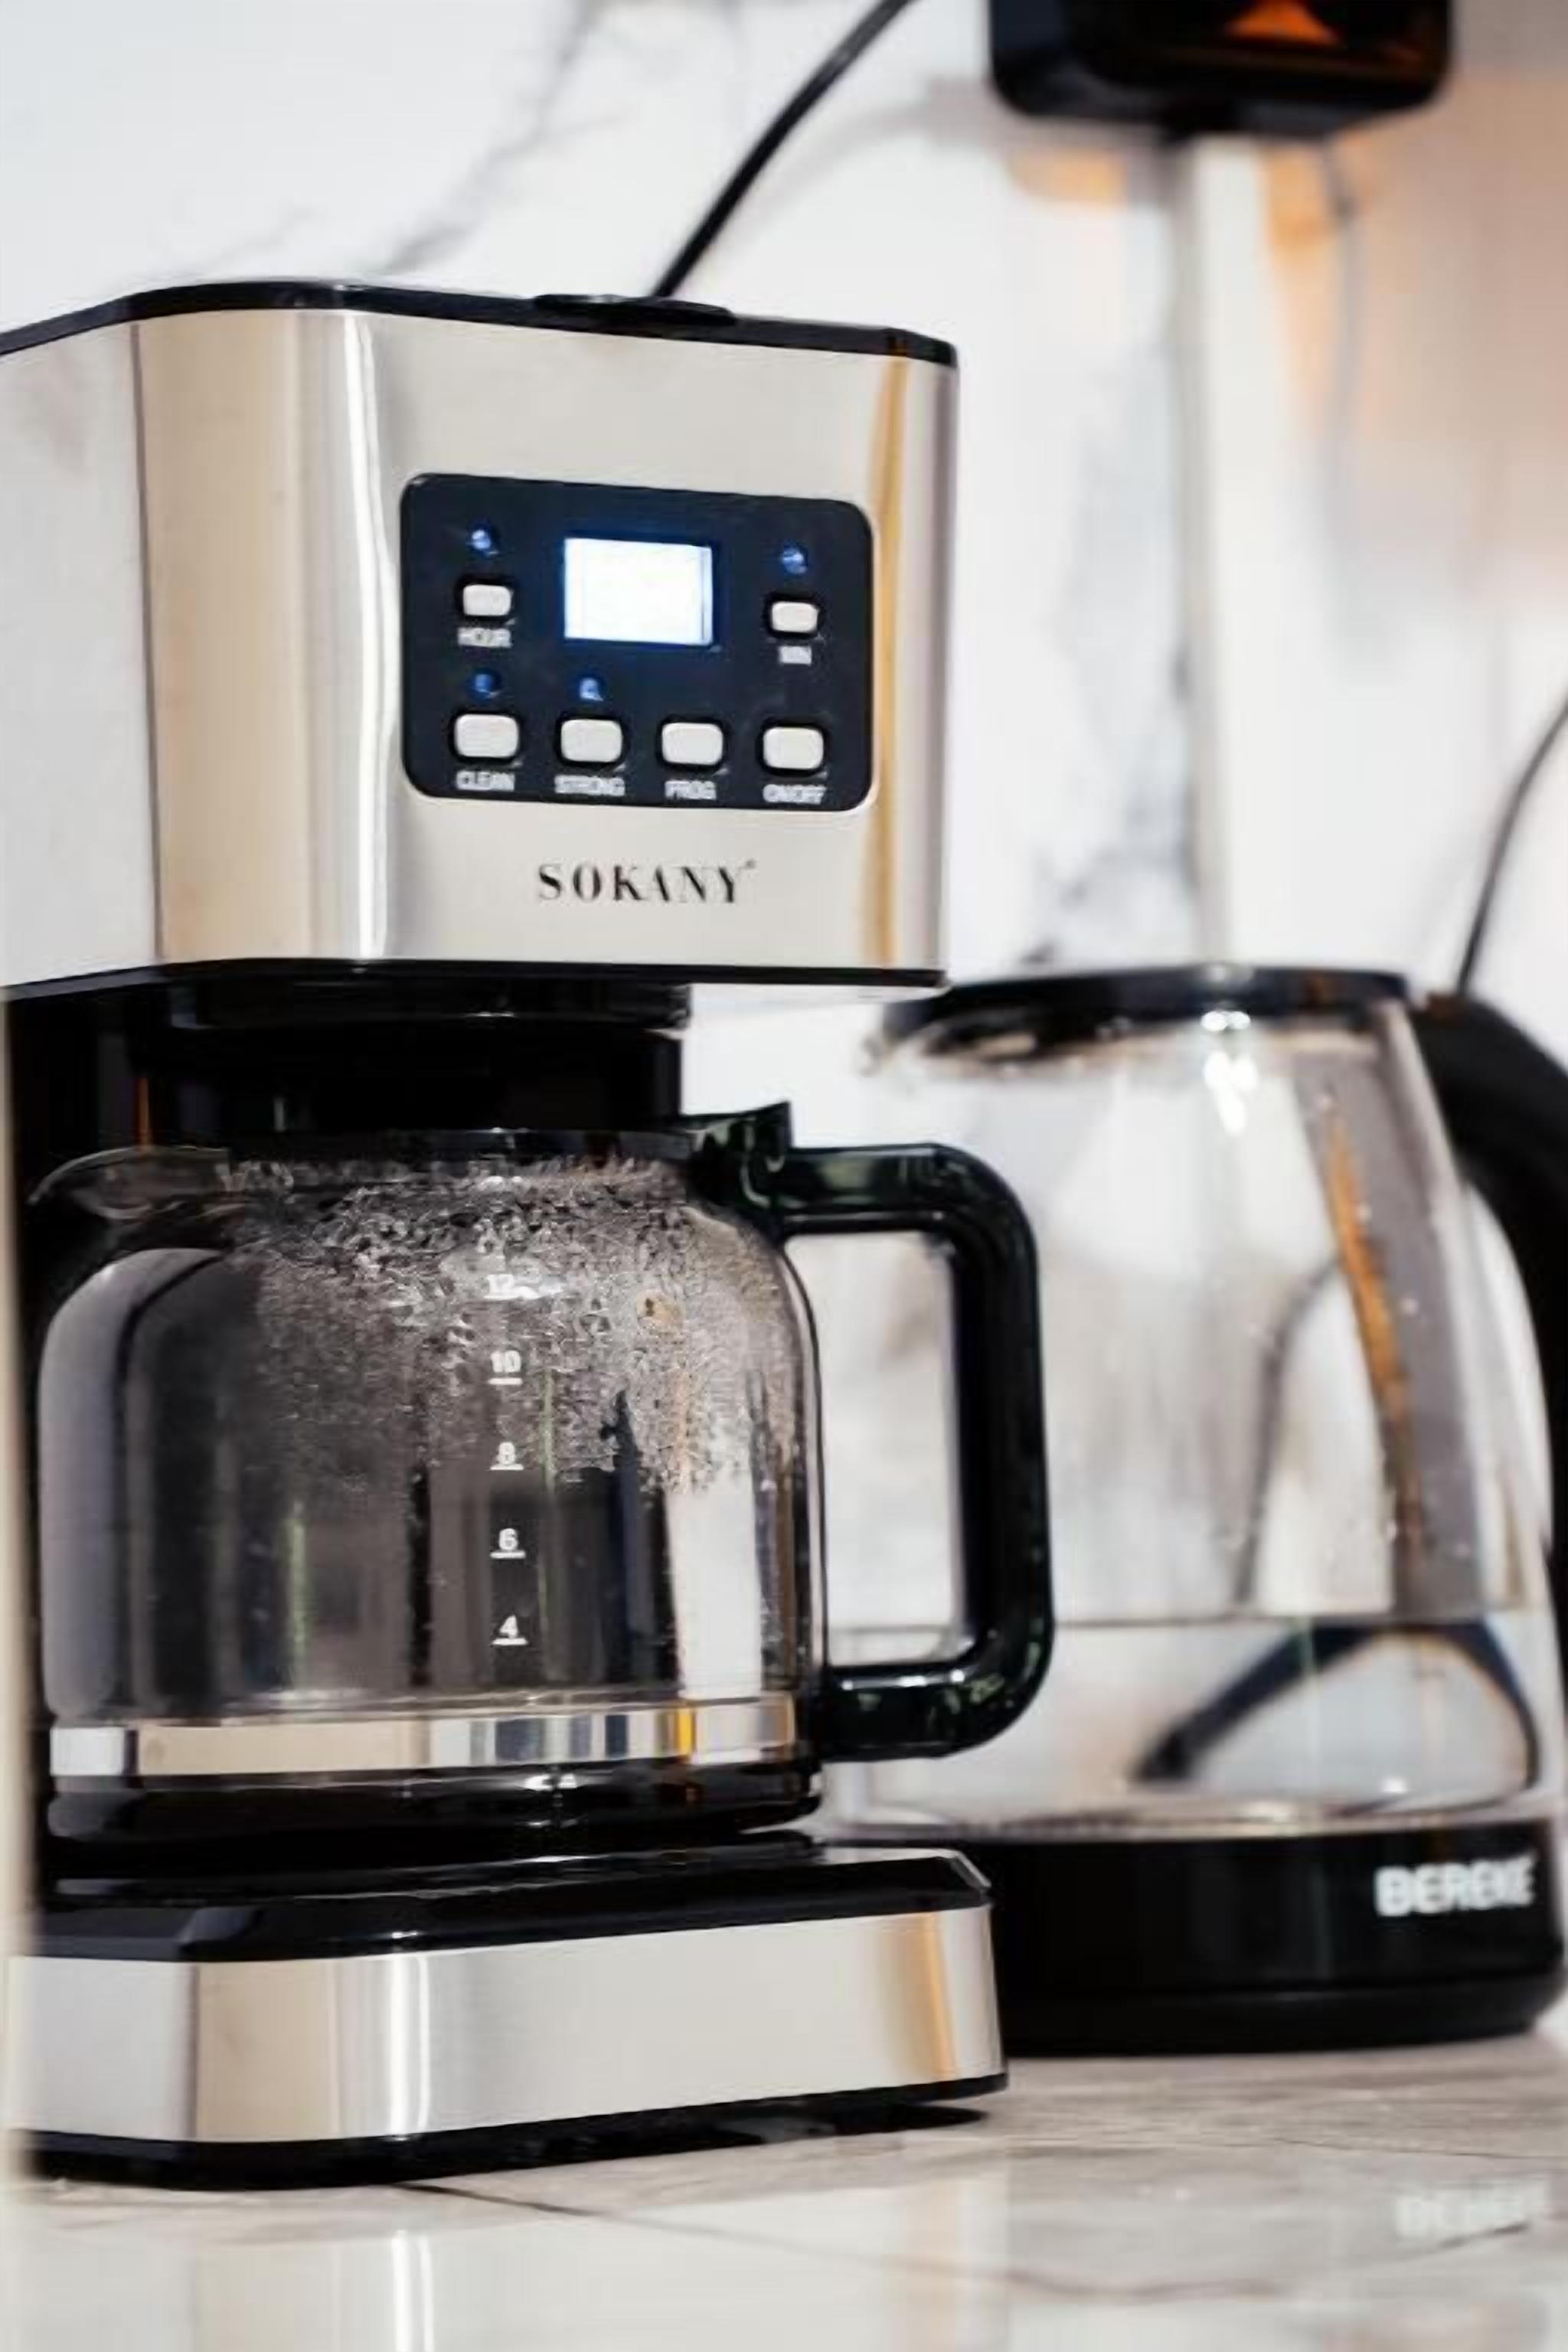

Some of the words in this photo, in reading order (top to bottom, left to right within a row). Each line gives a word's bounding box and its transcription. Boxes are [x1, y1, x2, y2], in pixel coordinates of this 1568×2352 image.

[537, 862, 736, 904] SOKANY
[491, 1350, 521, 1373] 10
[497, 1441, 516, 1466] 8
[498, 1528, 518, 1551] 6
[500, 1615, 518, 1639] 4
